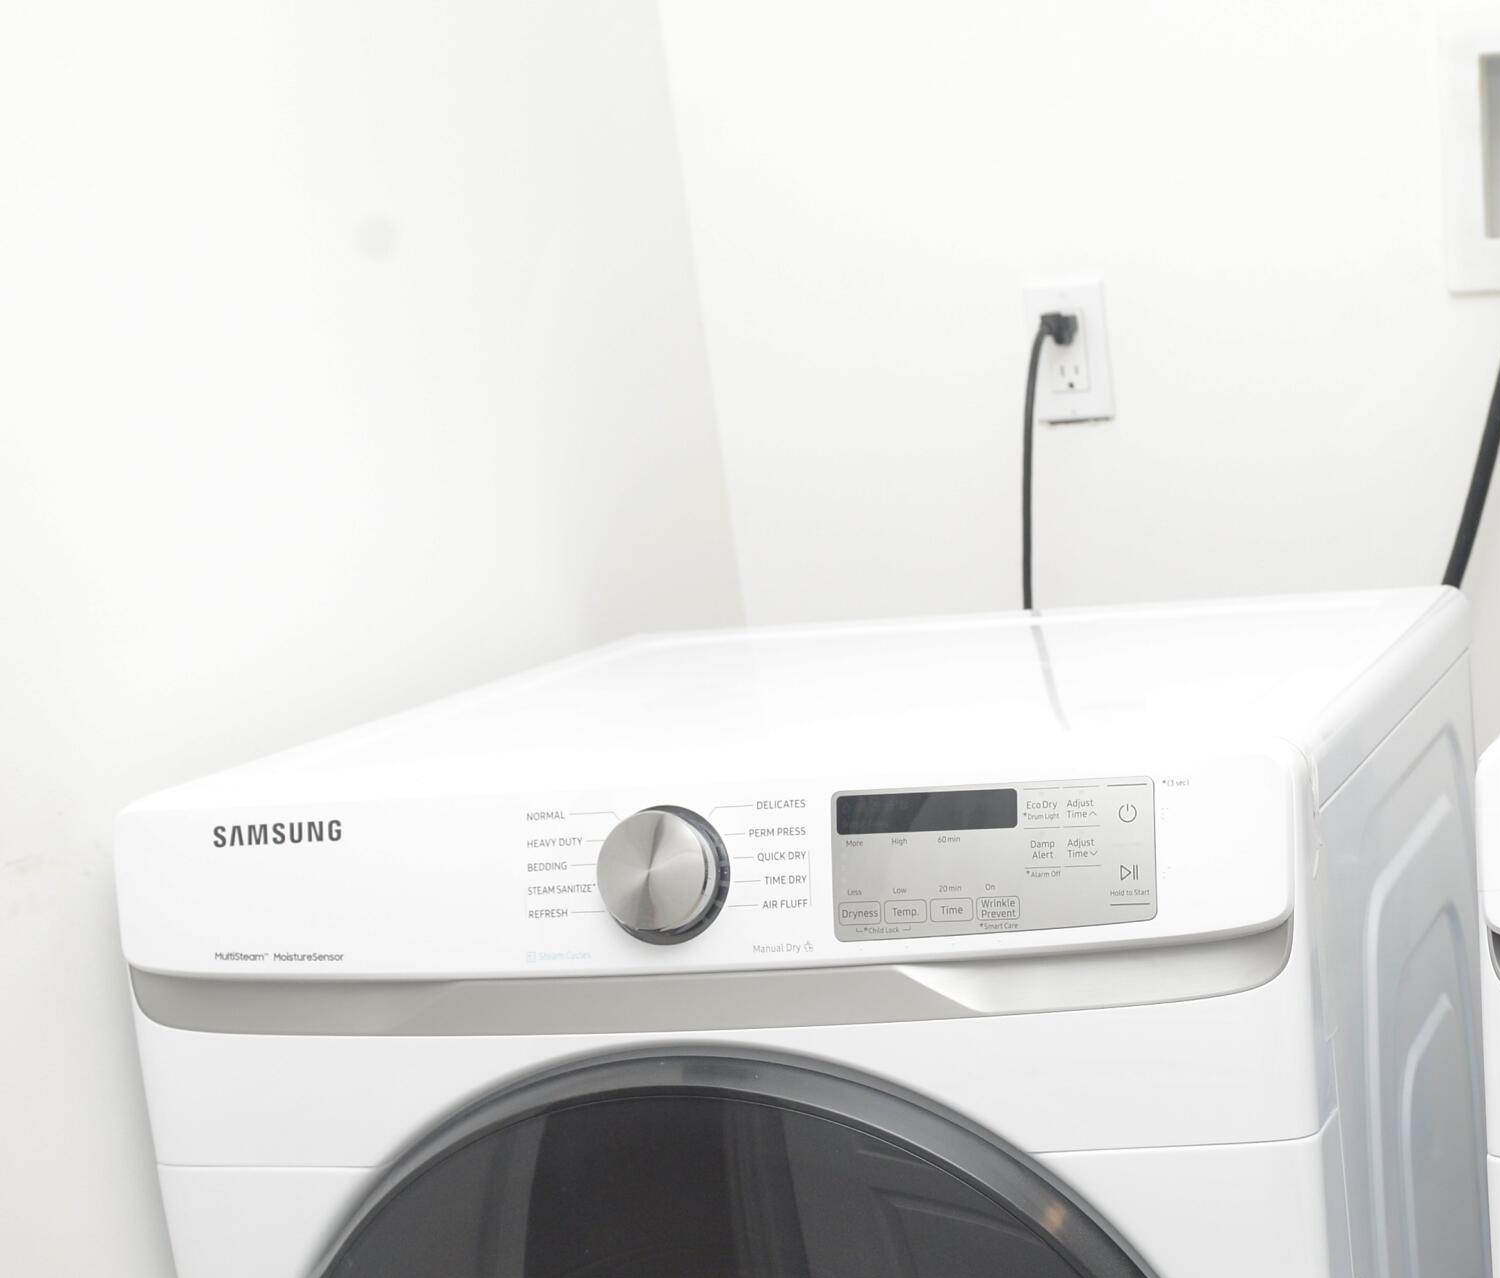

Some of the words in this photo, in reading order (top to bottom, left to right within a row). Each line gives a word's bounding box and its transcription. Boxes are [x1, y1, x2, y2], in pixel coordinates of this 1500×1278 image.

[756, 800, 806, 809] DELICATES
[1026, 801, 1041, 809] Eco
[1042, 800, 1058, 810] Dry
[1067, 799, 1094, 809] Adjust
[526, 811, 565, 821] NORMAL
[1045, 812, 1060, 820] Light
[1067, 810, 1087, 818] Time
[213, 819, 342, 848] SAMSUNG
[749, 828, 775, 838] PERM
[777, 827, 806, 836] PRESS
[527, 839, 556, 848] HEAVY
[559, 837, 583, 847] DUTY
[891, 838, 908, 846] High
[1030, 840, 1055, 850] Damp
[1067, 839, 1095, 848] Adjust
[757, 852, 786, 862] QUICK
[788, 851, 806, 860] DRY
[1032, 851, 1054, 859] Alert
[1068, 850, 1088, 858] Time
[527, 861, 567, 872] BEDDING
[765, 876, 786, 885] TIME
[789, 875, 807, 884] DRY
[527, 886, 555, 895] STEAM
[556, 884, 592, 894] SANITIZE
[939, 885, 948, 893] 20
[762, 900, 778, 909] AIR
[780, 899, 808, 908] FLUFF
[981, 899, 1016, 908] Wrinkle
[528, 909, 568, 919] REFRESH
[842, 908, 879, 920] Dryness
[893, 908, 920, 917] Temp.
[941, 905, 964, 915] Time
[981, 909, 1016, 918] Prevent
[752, 944, 784, 953] Manual
[786, 943, 801, 953] Dry
[273, 952, 344, 961] MoistureSensor
